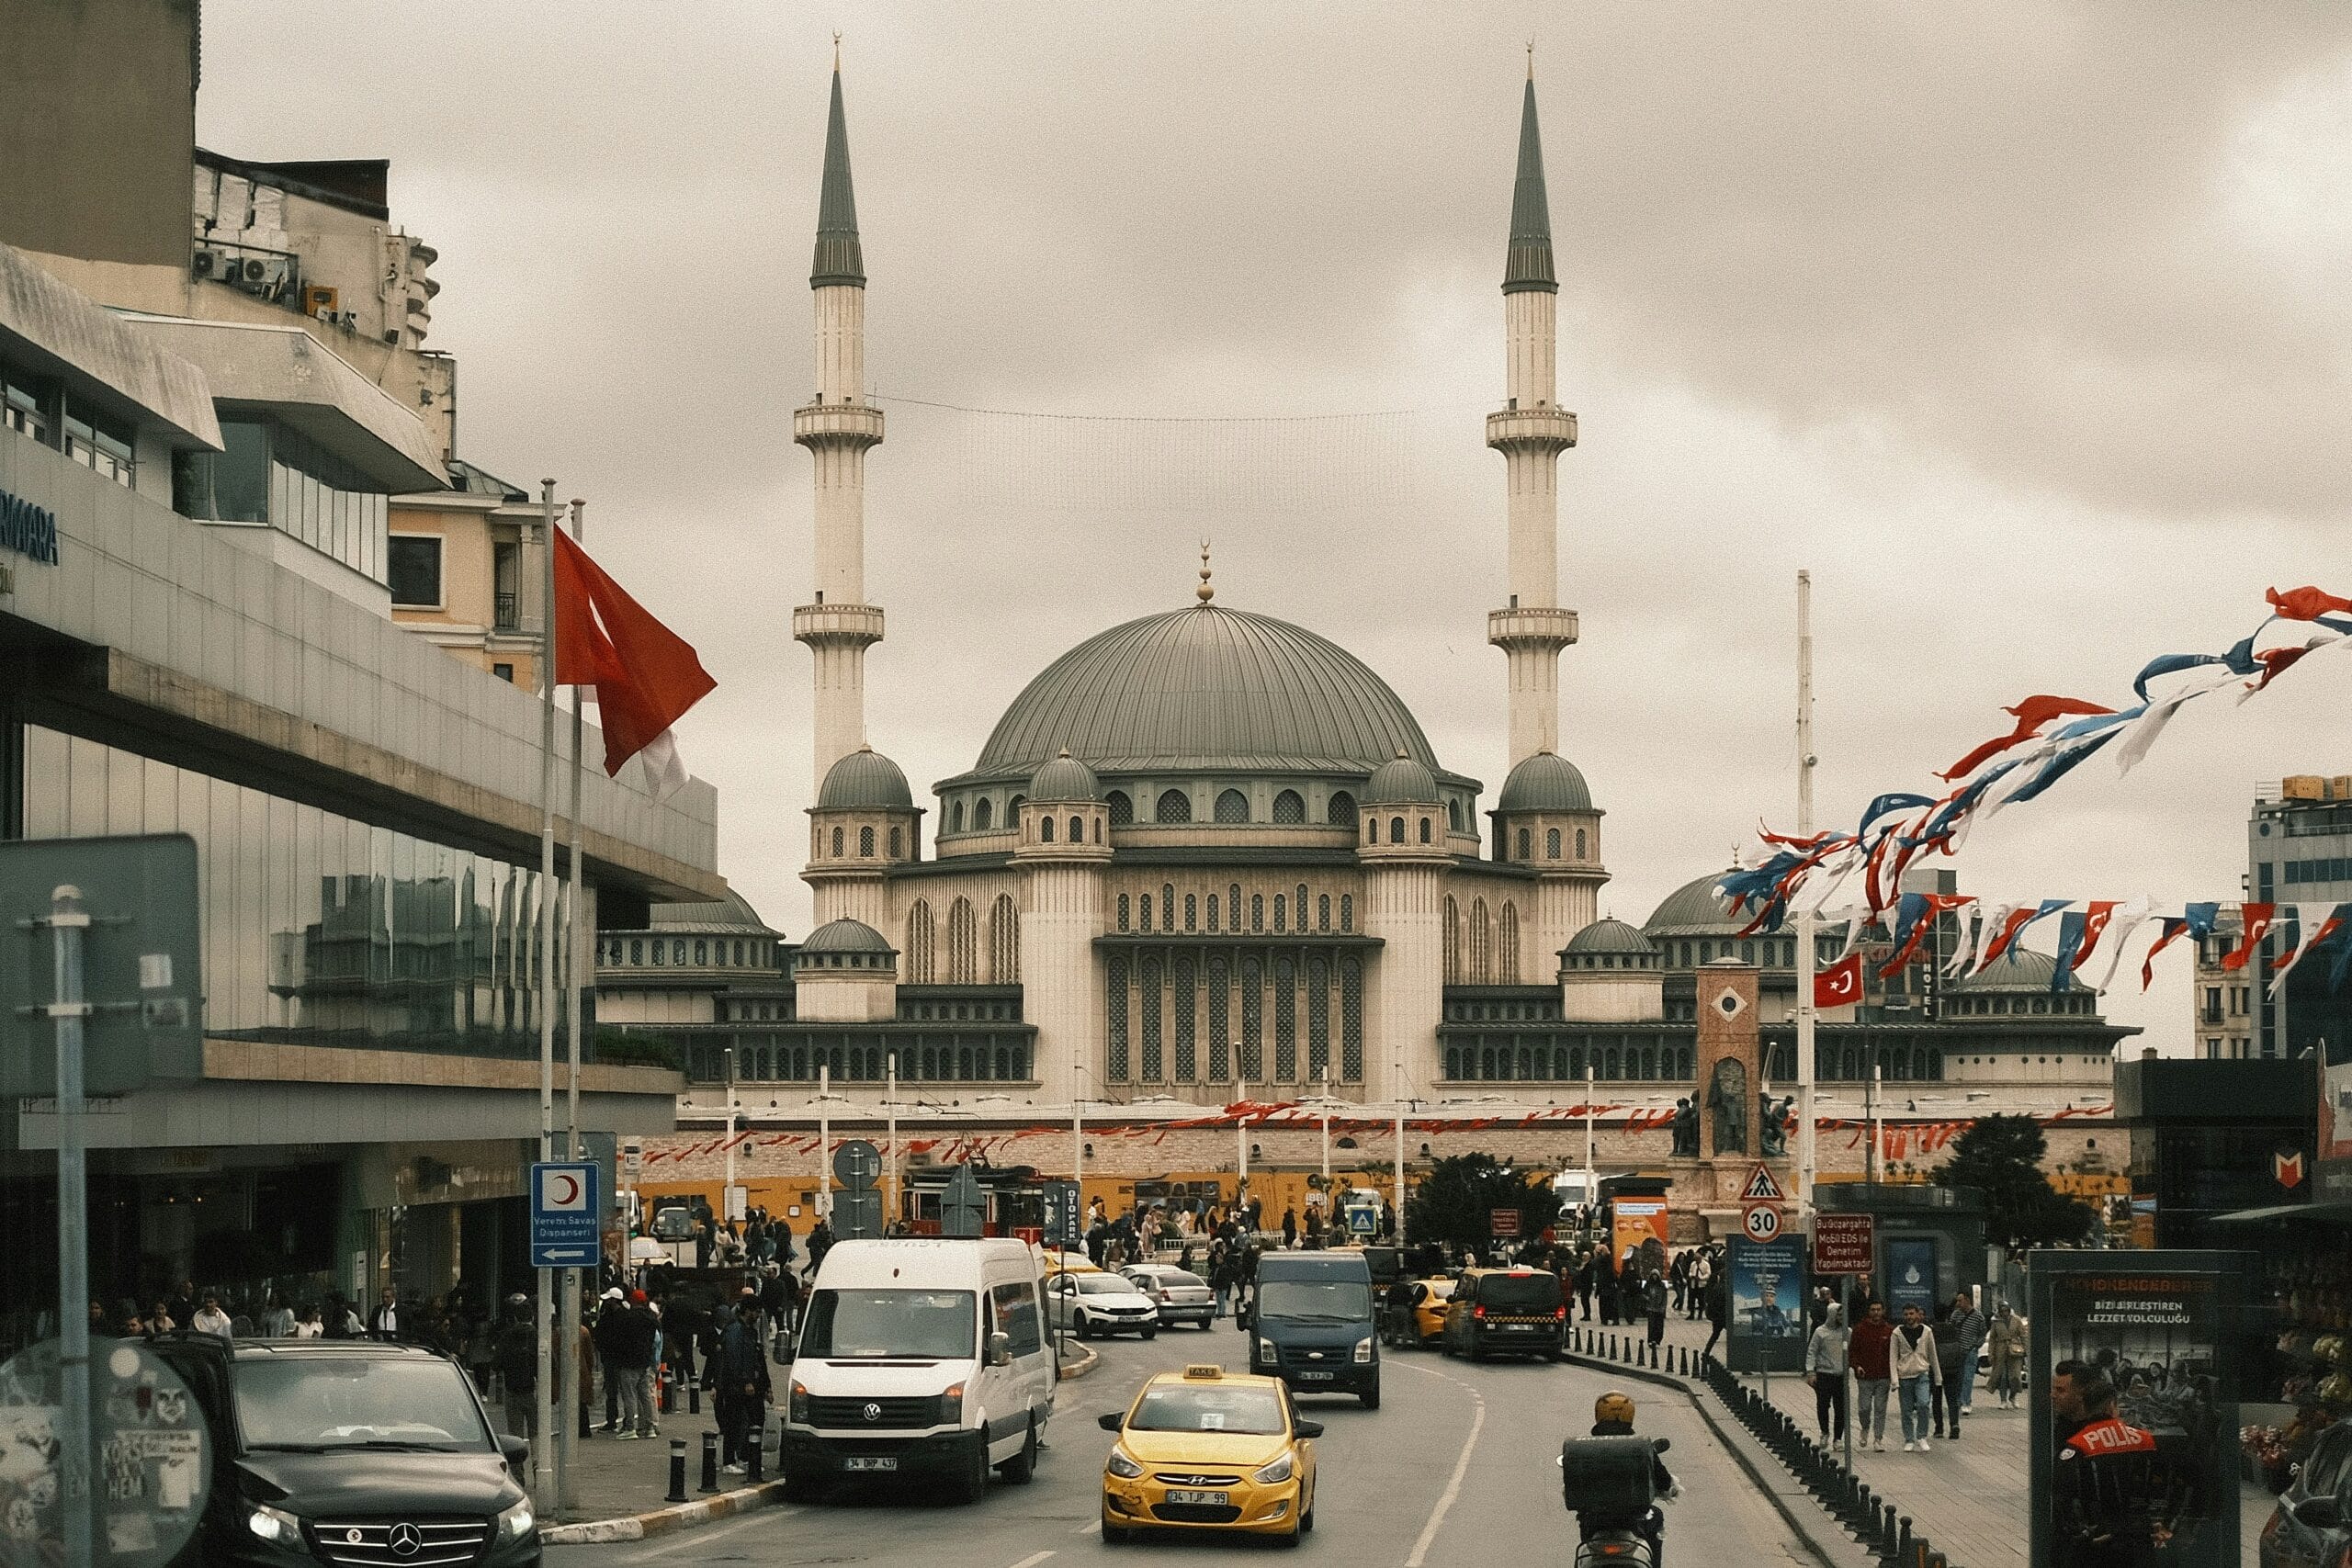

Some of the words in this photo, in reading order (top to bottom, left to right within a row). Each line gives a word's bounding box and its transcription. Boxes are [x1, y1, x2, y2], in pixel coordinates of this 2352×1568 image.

[1923, 964, 1931, 1016] HOTEL
[534, 1217, 566, 1225] Verem
[1750, 1213, 1774, 1232] 30
[539, 1228, 591, 1237] Dispanseri
[1841, 1234, 1858, 1244] EDS
[1826, 1246, 1861, 1256] Denetim
[2087, 1314, 2125, 1323] LEZZET
[2127, 1313, 2190, 1324] YOLCULUĞU
[850, 1459, 859, 1468] 34
[1172, 1491, 1182, 1502] 34
[1189, 1492, 1205, 1503] TJP
[1214, 1493, 1226, 1504] 99
